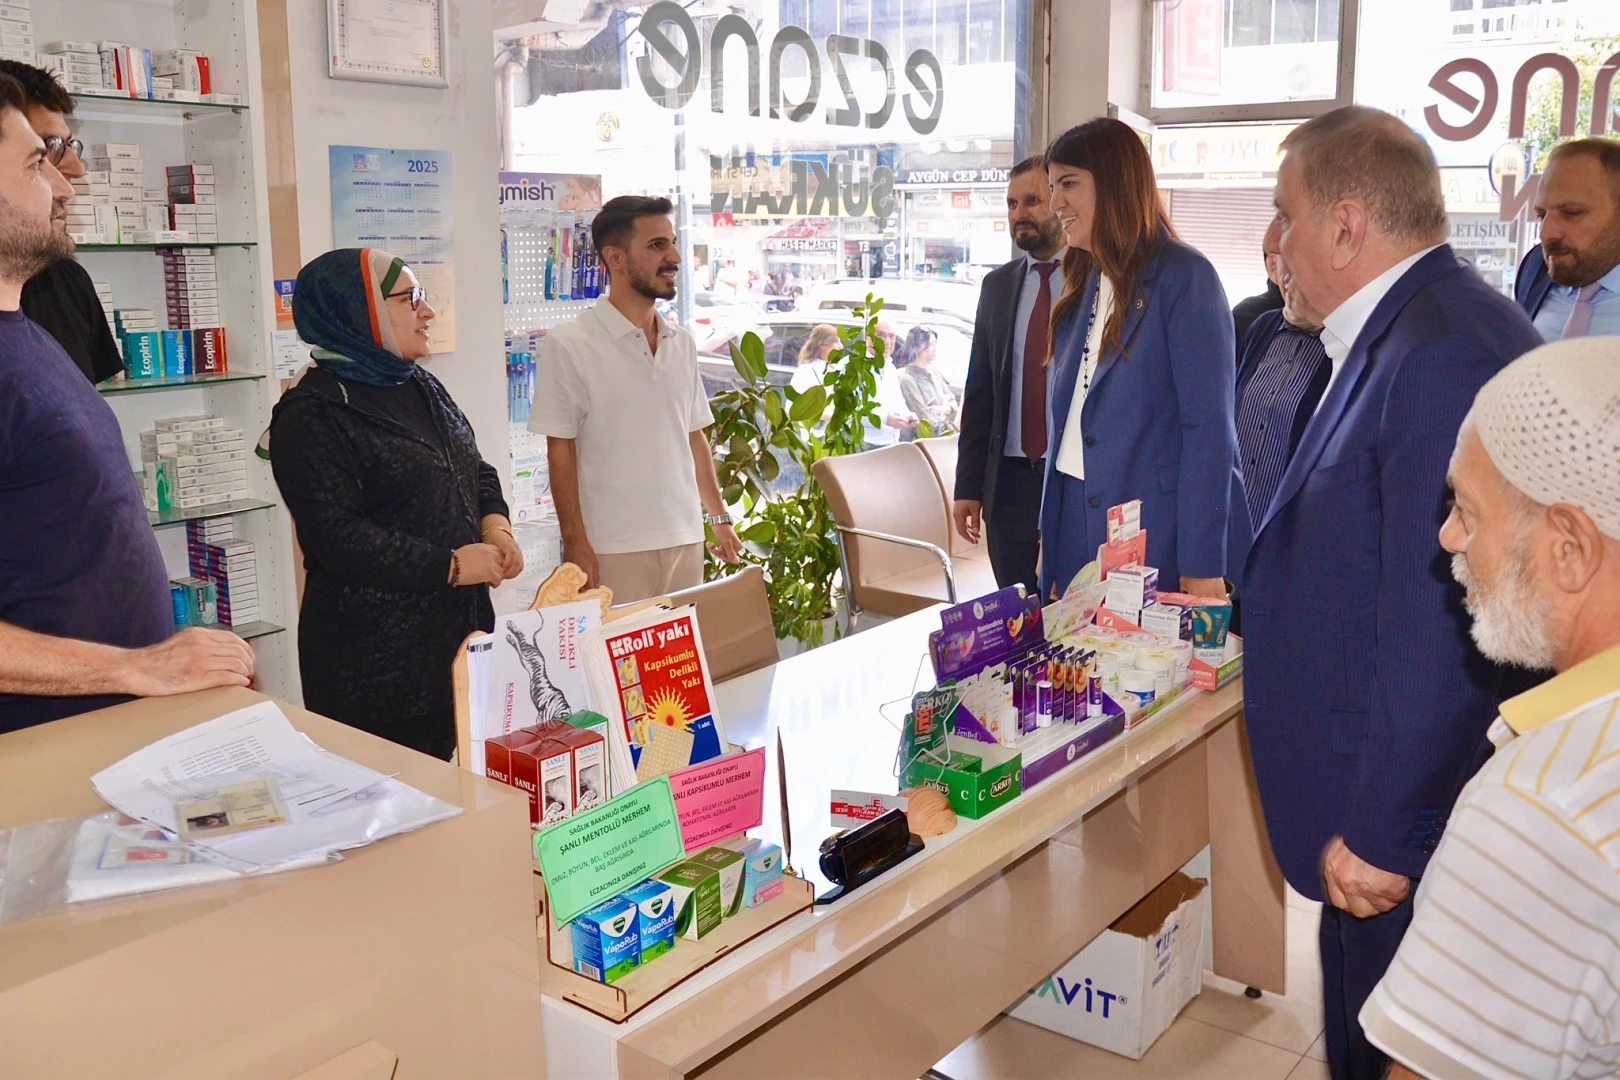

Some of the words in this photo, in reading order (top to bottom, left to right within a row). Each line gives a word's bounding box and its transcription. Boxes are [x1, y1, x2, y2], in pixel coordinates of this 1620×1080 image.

[408, 160, 439, 173] 2025
[907, 168, 949, 183] AYGÜN
[953, 171, 977, 183] CEP
[781, 240, 796, 250] HAS
[798, 240, 807, 250] ET
[809, 240, 838, 250] MARKET
[140, 335, 152, 376] Ecopirin
[177, 344, 186, 374] Ecopirin
[203, 331, 216, 370] Ecopirin
[610, 629, 655, 658] KRoll
[657, 622, 690, 649] yakı
[644, 649, 695, 672] Kapsikumlu
[669, 662, 698, 679] Delikli
[682, 677, 700, 689] Yakı
[956, 728, 978, 739] JenBol
[487, 767, 508, 782] ŞANLI
[514, 777, 536, 792] ŞANLI
[681, 776, 698, 787] SAĞLIK
[698, 768, 722, 782] BAKANLIĞI
[687, 781, 724, 797] KAPSİKUMLU
[725, 771, 751, 785] MERHEM
[569, 822, 590, 836] SAĞLIK
[590, 808, 620, 828] BAKANLIĞI
[620, 798, 639, 812] ONAYLI
[559, 839, 582, 856] ŞANLI
[582, 818, 621, 844] MENTOLLÜ
[622, 804, 651, 825] MERHEM
[603, 845, 621, 859] EKLEM
[621, 843, 628, 851] VE
[638, 819, 672, 840] AĞRILARINDA
[595, 862, 606, 873] BAŞ
[606, 849, 635, 869] AĞRISINDA
[589, 876, 621, 897] ECZACINIZA
[621, 862, 647, 881] DANIŞINIZ
[642, 915, 674, 936] VapoRub
[604, 933, 639, 955] VapoRub
